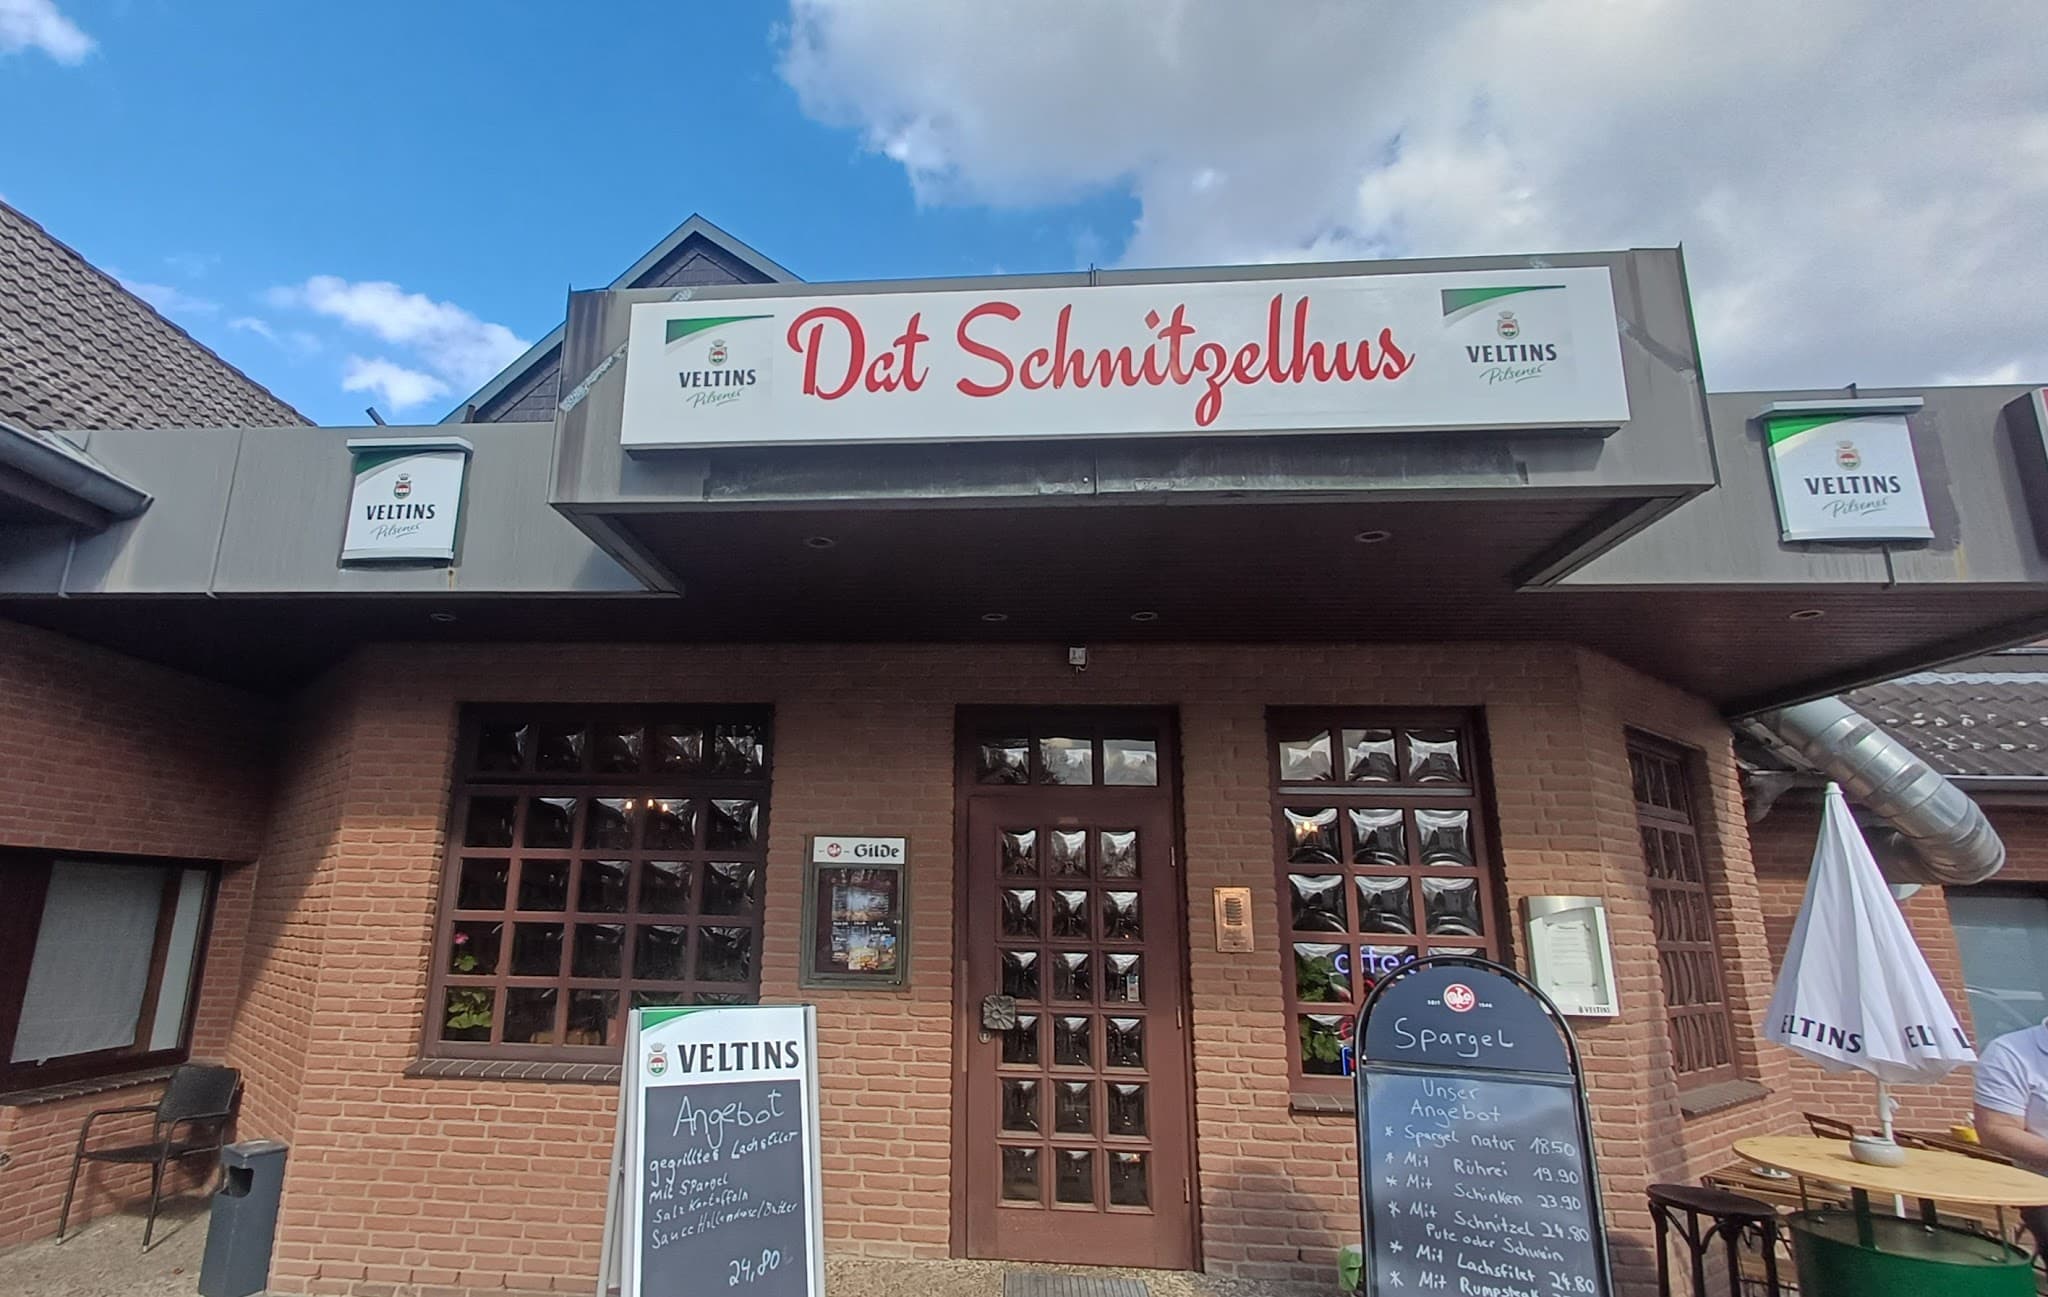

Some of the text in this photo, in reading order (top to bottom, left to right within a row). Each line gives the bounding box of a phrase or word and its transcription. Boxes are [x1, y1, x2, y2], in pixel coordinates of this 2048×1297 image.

[786, 292, 1416, 427] Dat Schnitzelhus
[1465, 343, 1557, 363] VELTINS
[679, 368, 756, 388] VELTINS
[1479, 363, 1546, 385] Pilsener
[686, 387, 744, 408] Pilsener
[1804, 475, 1901, 495] VELTINS
[366, 503, 436, 520] VELTINS
[1822, 497, 1888, 518] Pilsener
[370, 522, 422, 541] Pilsener
[854, 843, 900, 858] Gilde
[1394, 1017, 1515, 1058] Spargel
[1780, 1014, 1862, 1053] ELTINS
[677, 1040, 800, 1074] VELTINS
[1422, 1079, 1480, 1100] Unser
[673, 1089, 785, 1150] Angebot
[1410, 1098, 1502, 1128] Angebot
[1404, 1124, 1459, 1149] Spargel
[1471, 1134, 1517, 1151] natur
[649, 1148, 720, 1188] gegrilltes
[1403, 1152, 1429, 1168] Mit
[1533, 1167, 1580, 1185] 19.90
[1406, 1174, 1582, 1210] Mit Schinken 23.90
[1409, 1201, 1590, 1242] Mit Schnitzel 24.80
[728, 1248, 781, 1287] 24,80
[1416, 1244, 1596, 1294] Mit Lachsfilet 24.80
[1418, 1271, 1447, 1290] Mit
